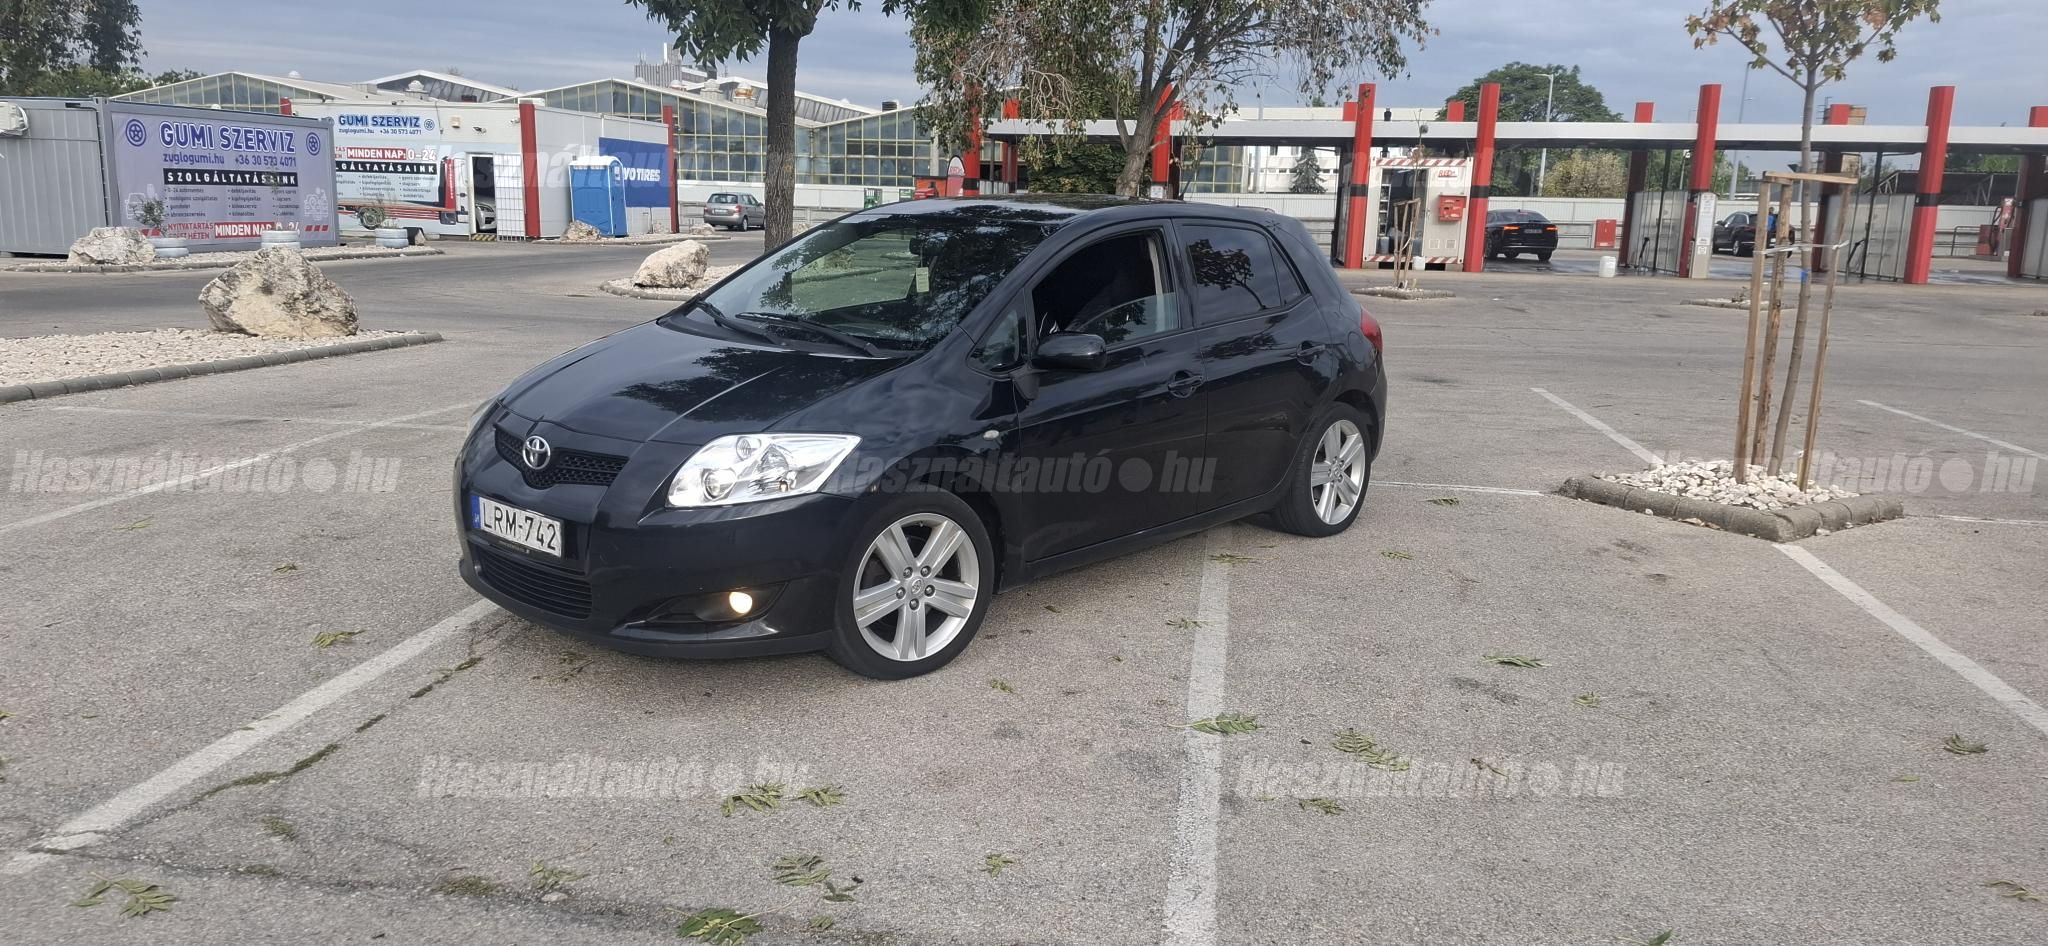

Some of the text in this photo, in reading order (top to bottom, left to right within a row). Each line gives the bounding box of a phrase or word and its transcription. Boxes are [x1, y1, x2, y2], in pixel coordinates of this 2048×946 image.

[339, 115, 420, 127] GUMI SZERVIZ
[160, 121, 296, 153] GUMI SZERVIZ
[163, 152, 225, 166] zuglogumi.hu
[235, 155, 250, 166] +36
[252, 155, 262, 166] 30
[280, 157, 297, 167] 4071
[347, 149, 382, 159] MINDEN
[637, 168, 661, 182] TIRES
[215, 224, 251, 237] MINDEN
[483, 502, 556, 550] LRM-742
